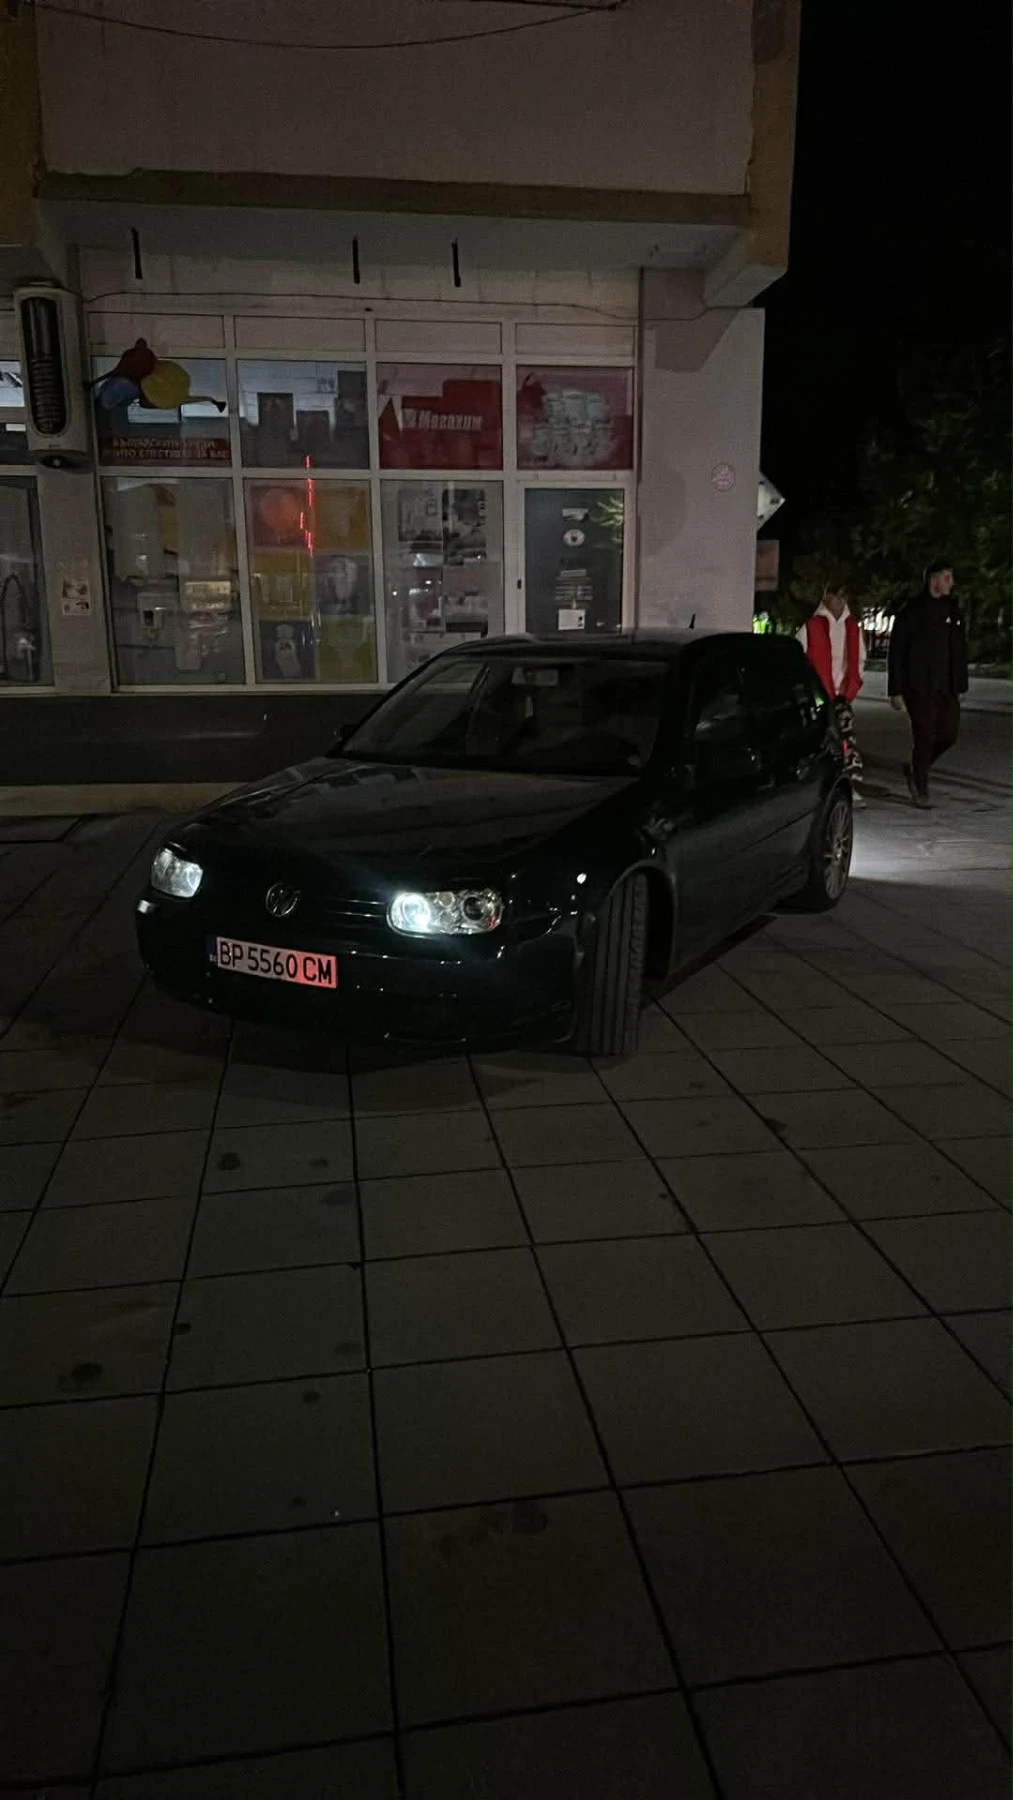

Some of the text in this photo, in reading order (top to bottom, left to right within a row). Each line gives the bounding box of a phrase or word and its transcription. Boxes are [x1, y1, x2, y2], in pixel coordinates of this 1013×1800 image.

[220, 941, 332, 985] BP 5560 CM
